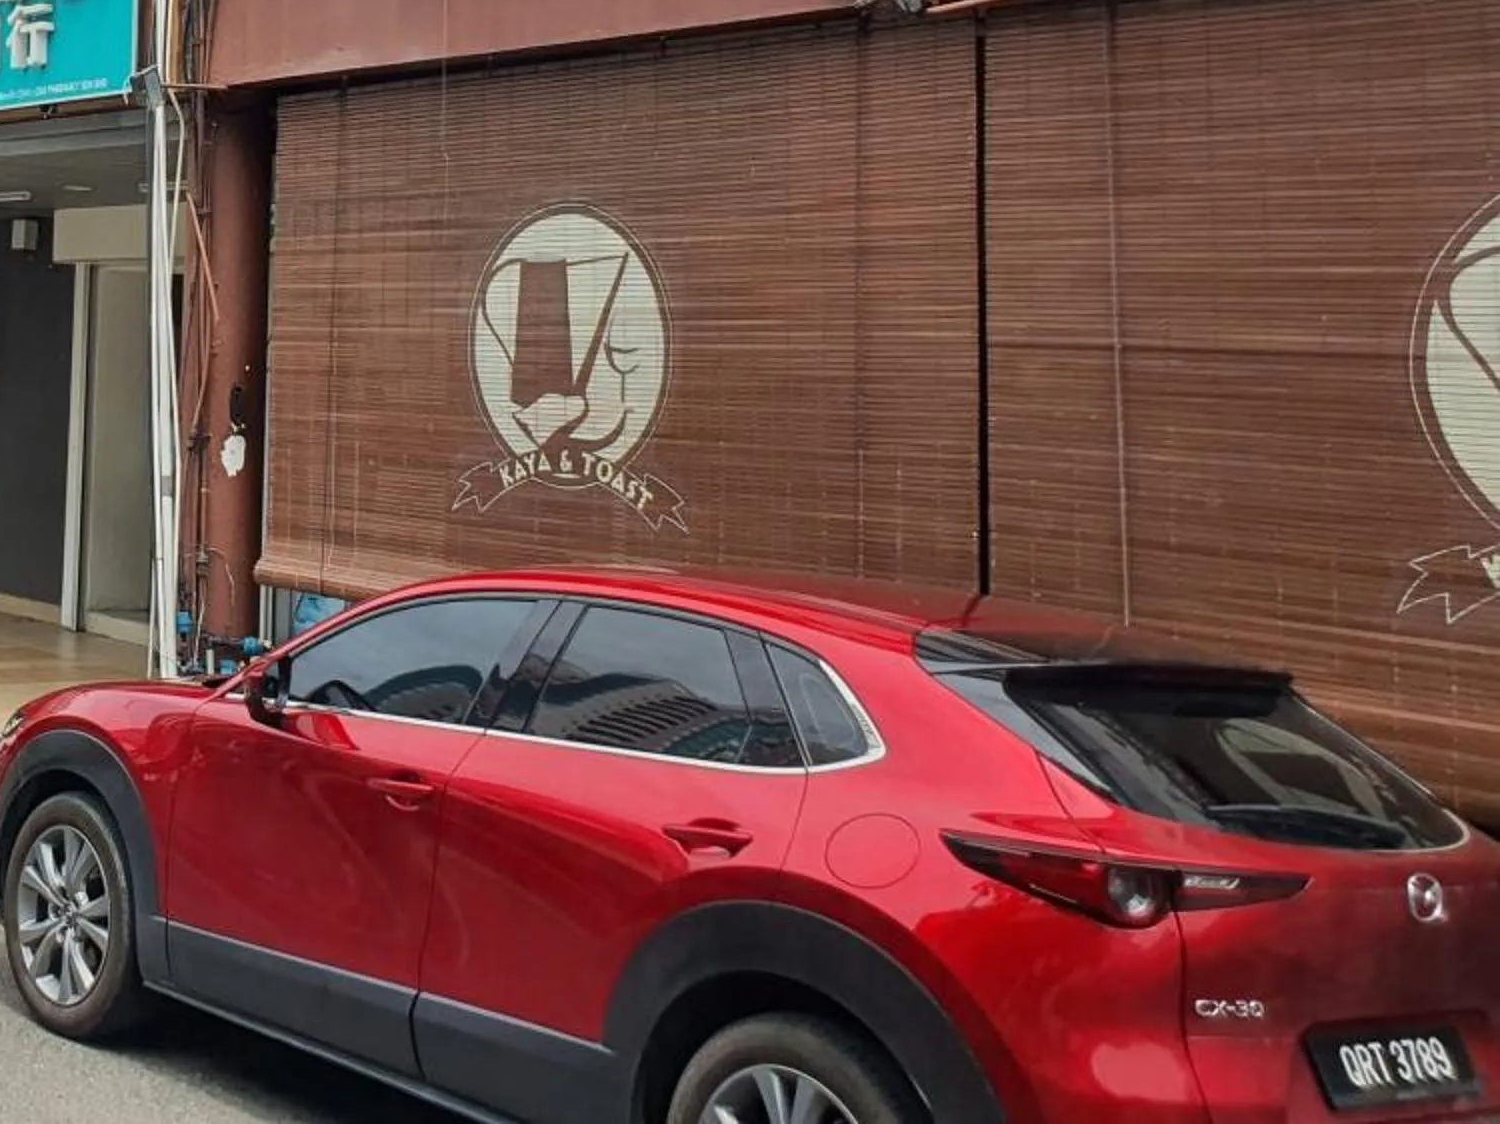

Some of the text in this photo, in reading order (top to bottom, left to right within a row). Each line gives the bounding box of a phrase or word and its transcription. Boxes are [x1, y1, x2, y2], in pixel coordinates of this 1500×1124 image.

[499, 449, 653, 511] KAYA & TOAST
[1195, 998, 1264, 1019] CX-30
[1339, 1036, 1458, 1088] QRT 3789
